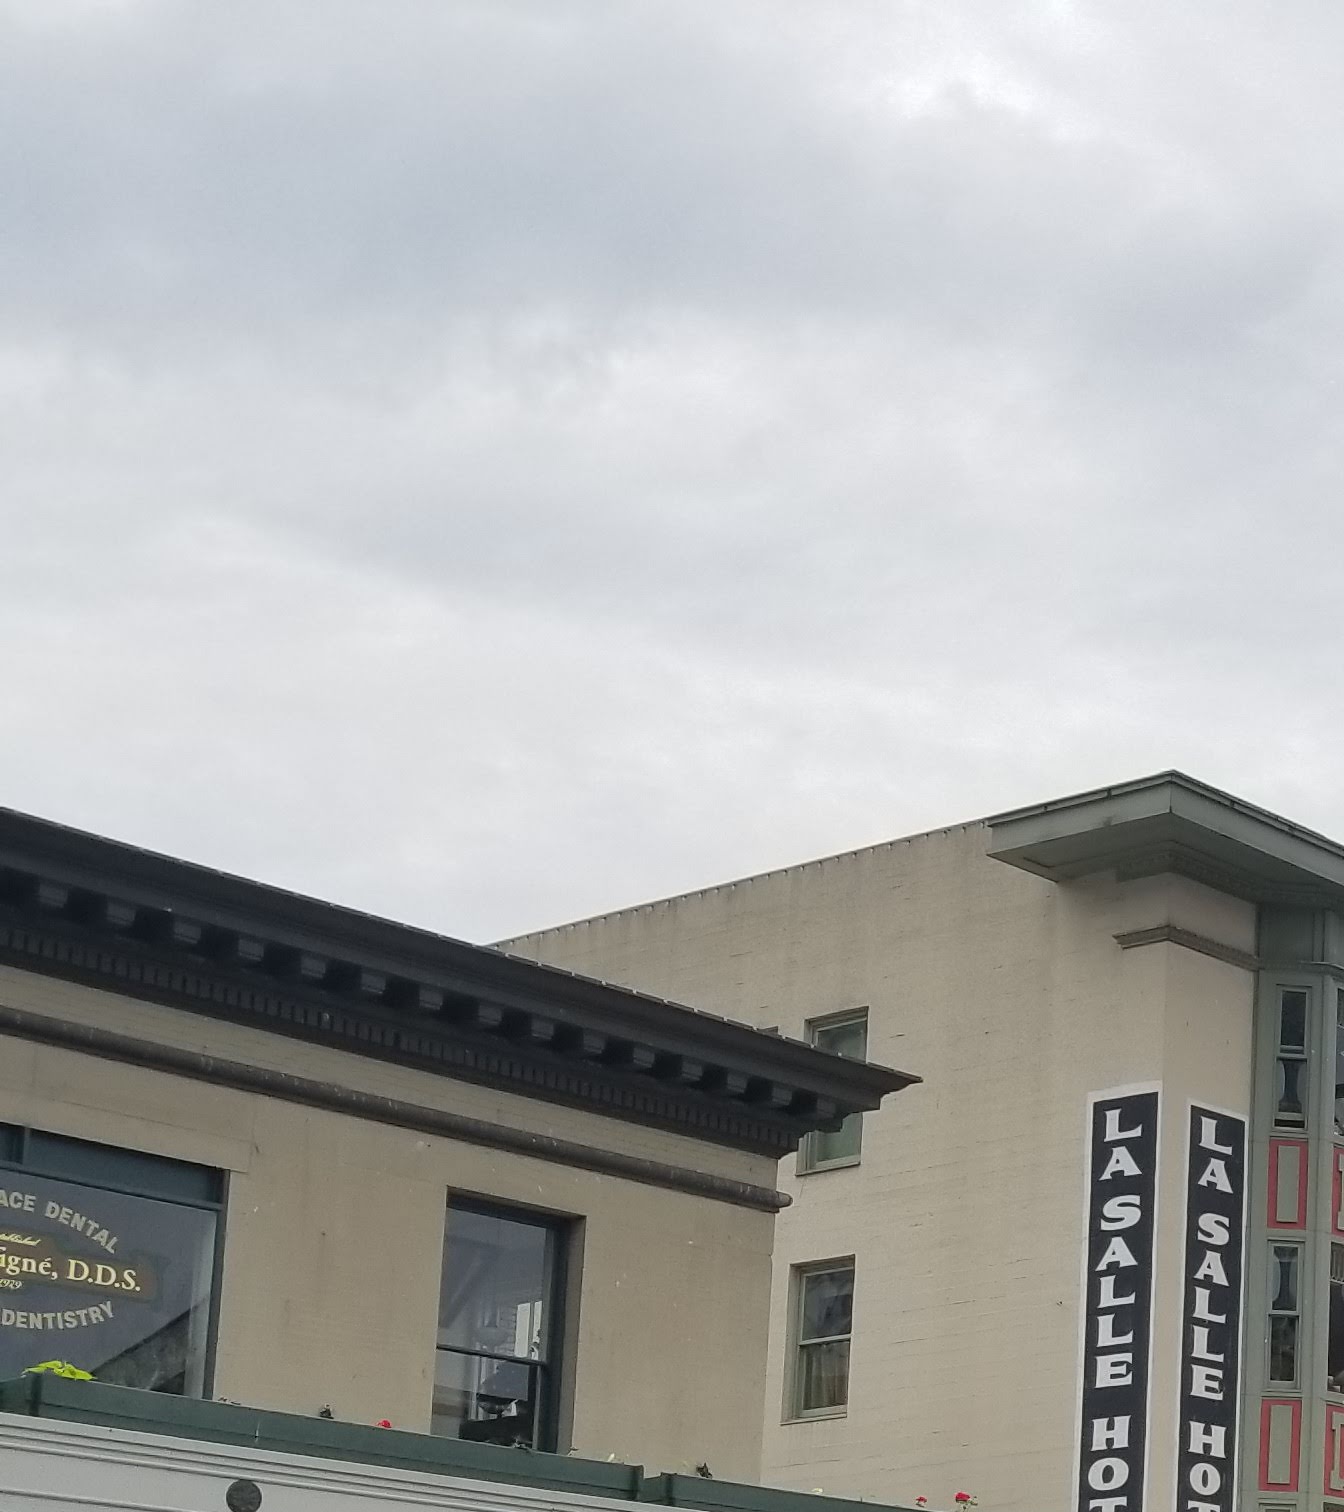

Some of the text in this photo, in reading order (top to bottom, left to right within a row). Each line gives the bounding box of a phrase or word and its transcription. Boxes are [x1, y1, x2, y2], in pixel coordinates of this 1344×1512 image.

[1099, 1108, 1143, 1181] LA
[1197, 1115, 1233, 1194] LA
[44, 1200, 119, 1255] DENTAL
[67, 1258, 141, 1292] D.D.S.
[1094, 1194, 1141, 1389] SALLE
[1190, 1213, 1230, 1402] SALLE
[1, 1300, 115, 1330] DENTISTRY
